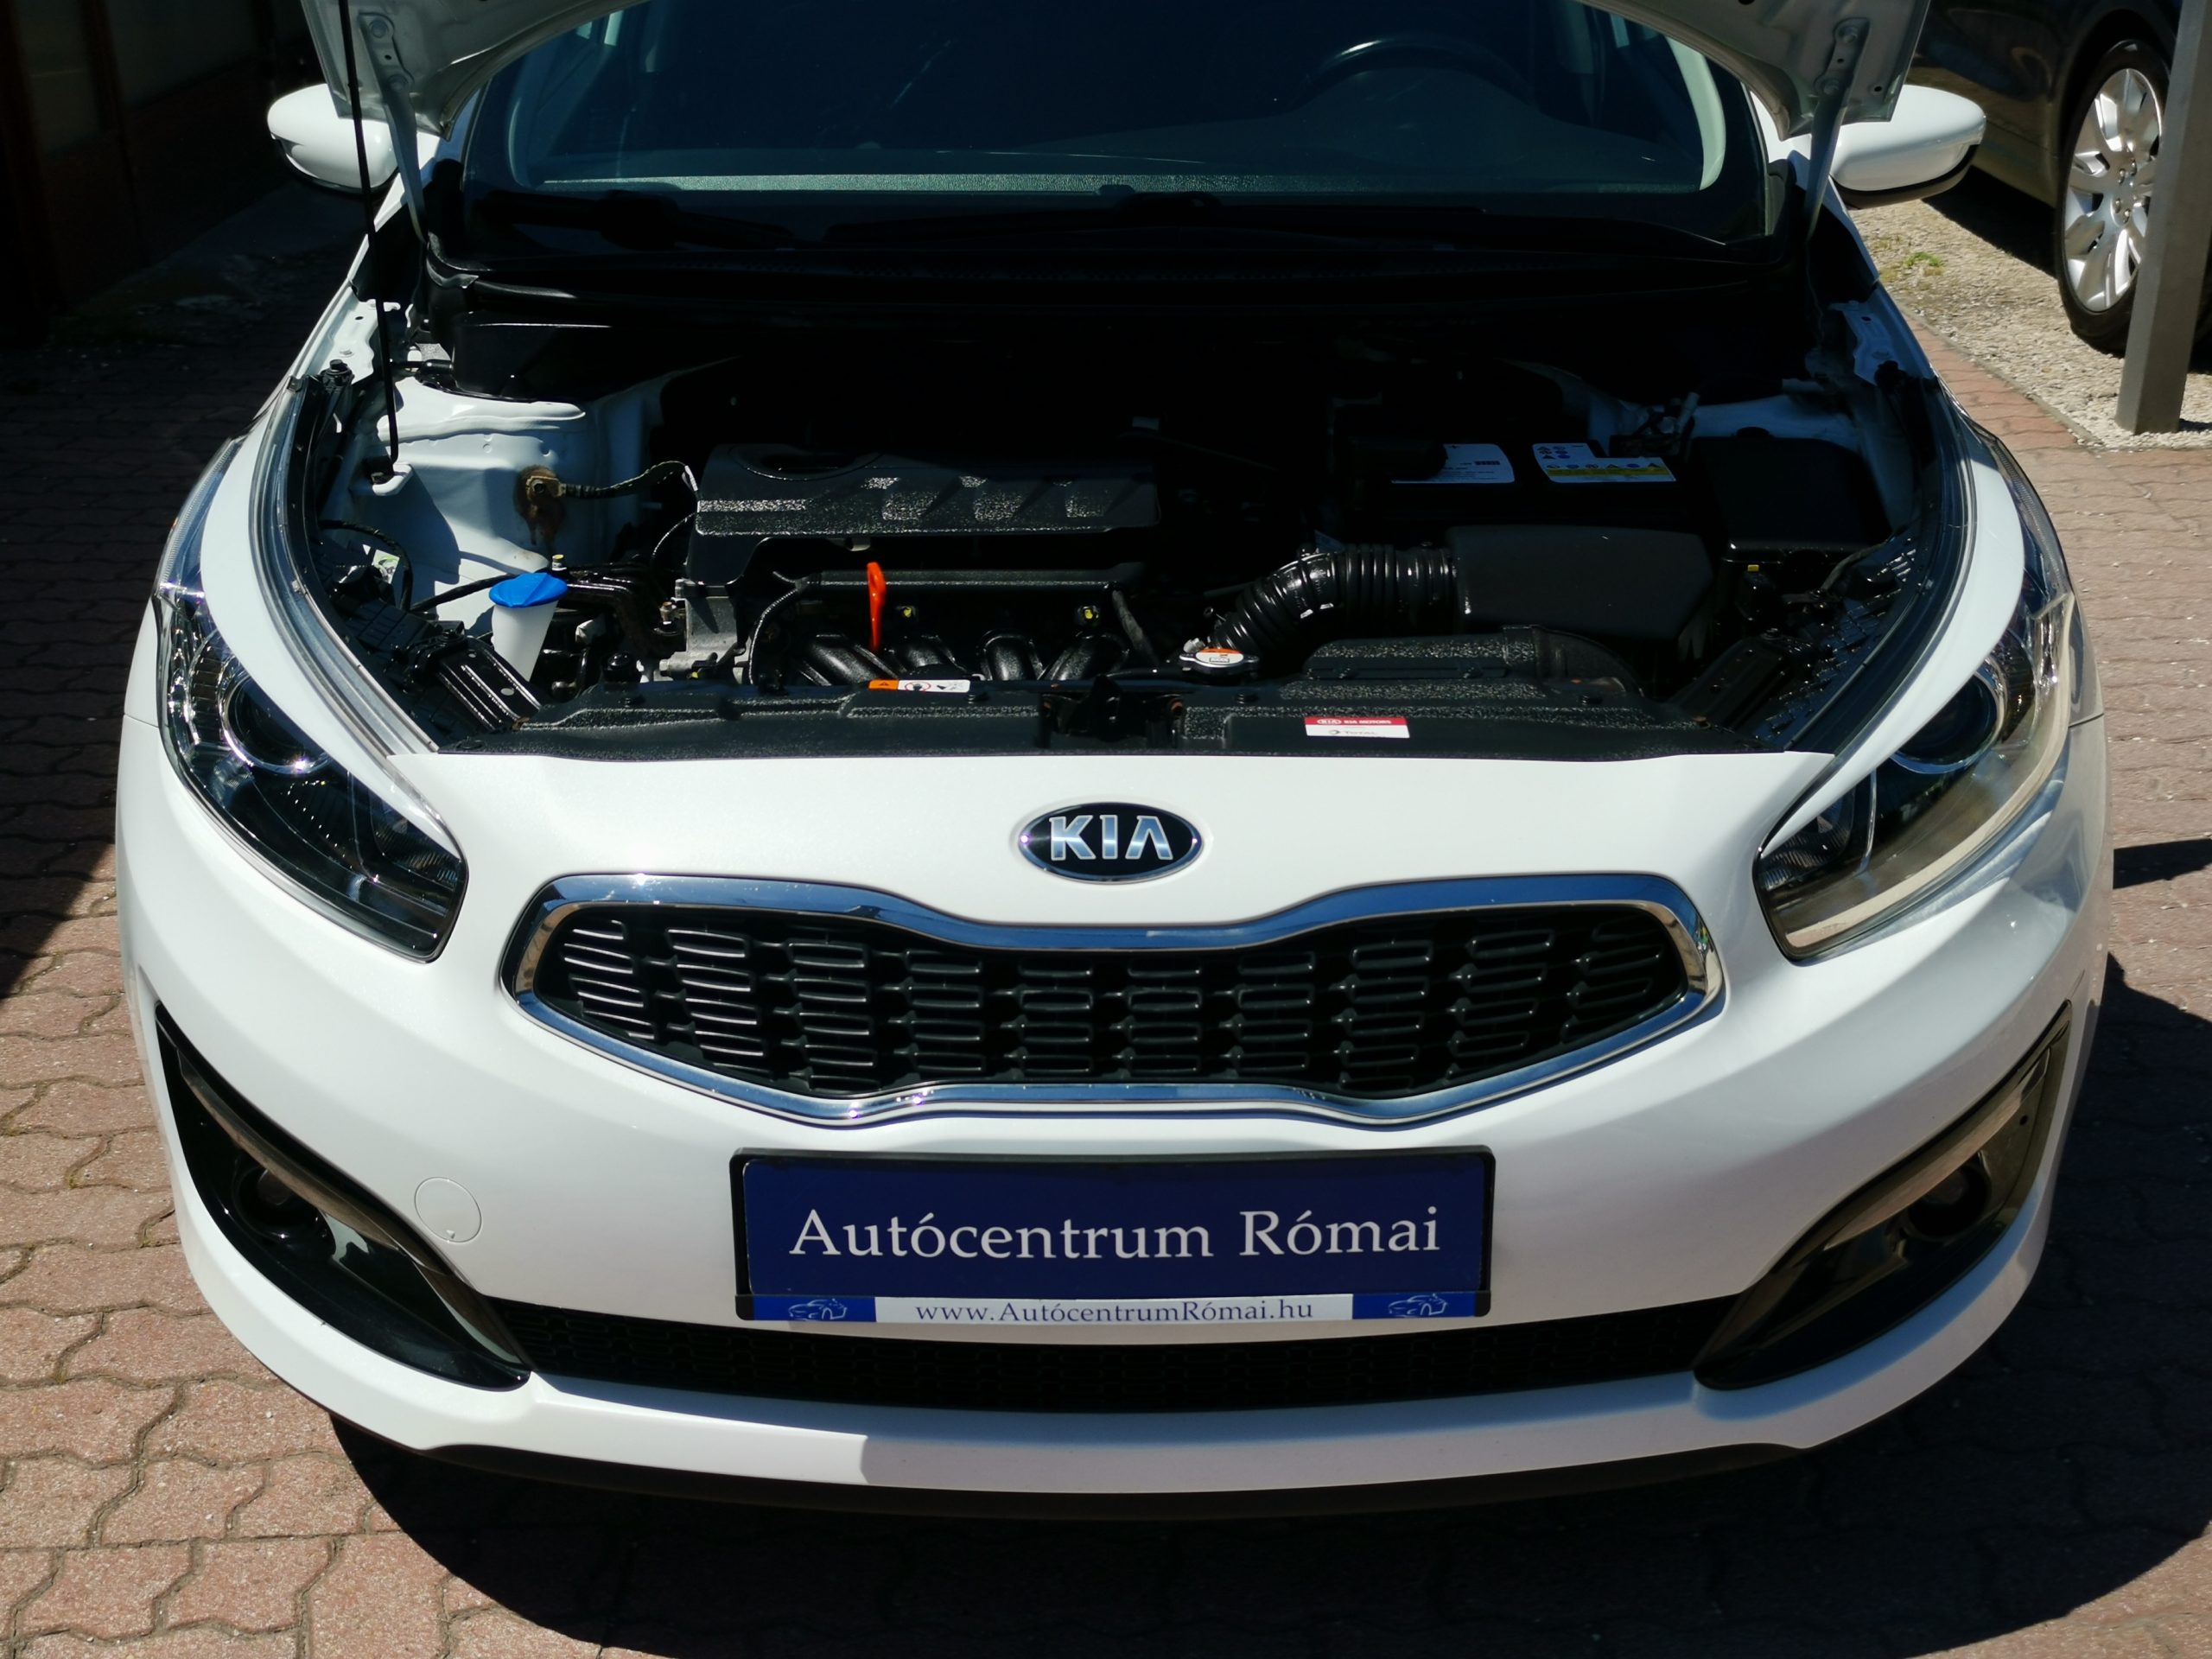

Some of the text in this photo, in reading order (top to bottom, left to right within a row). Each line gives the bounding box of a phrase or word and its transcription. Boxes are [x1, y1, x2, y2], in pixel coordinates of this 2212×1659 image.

[1049, 815, 1173, 861] KIA
[789, 1206, 1440, 1258] Autócentrum Római
[915, 1299, 1313, 1323] www.AutócentrumRómai.hu
